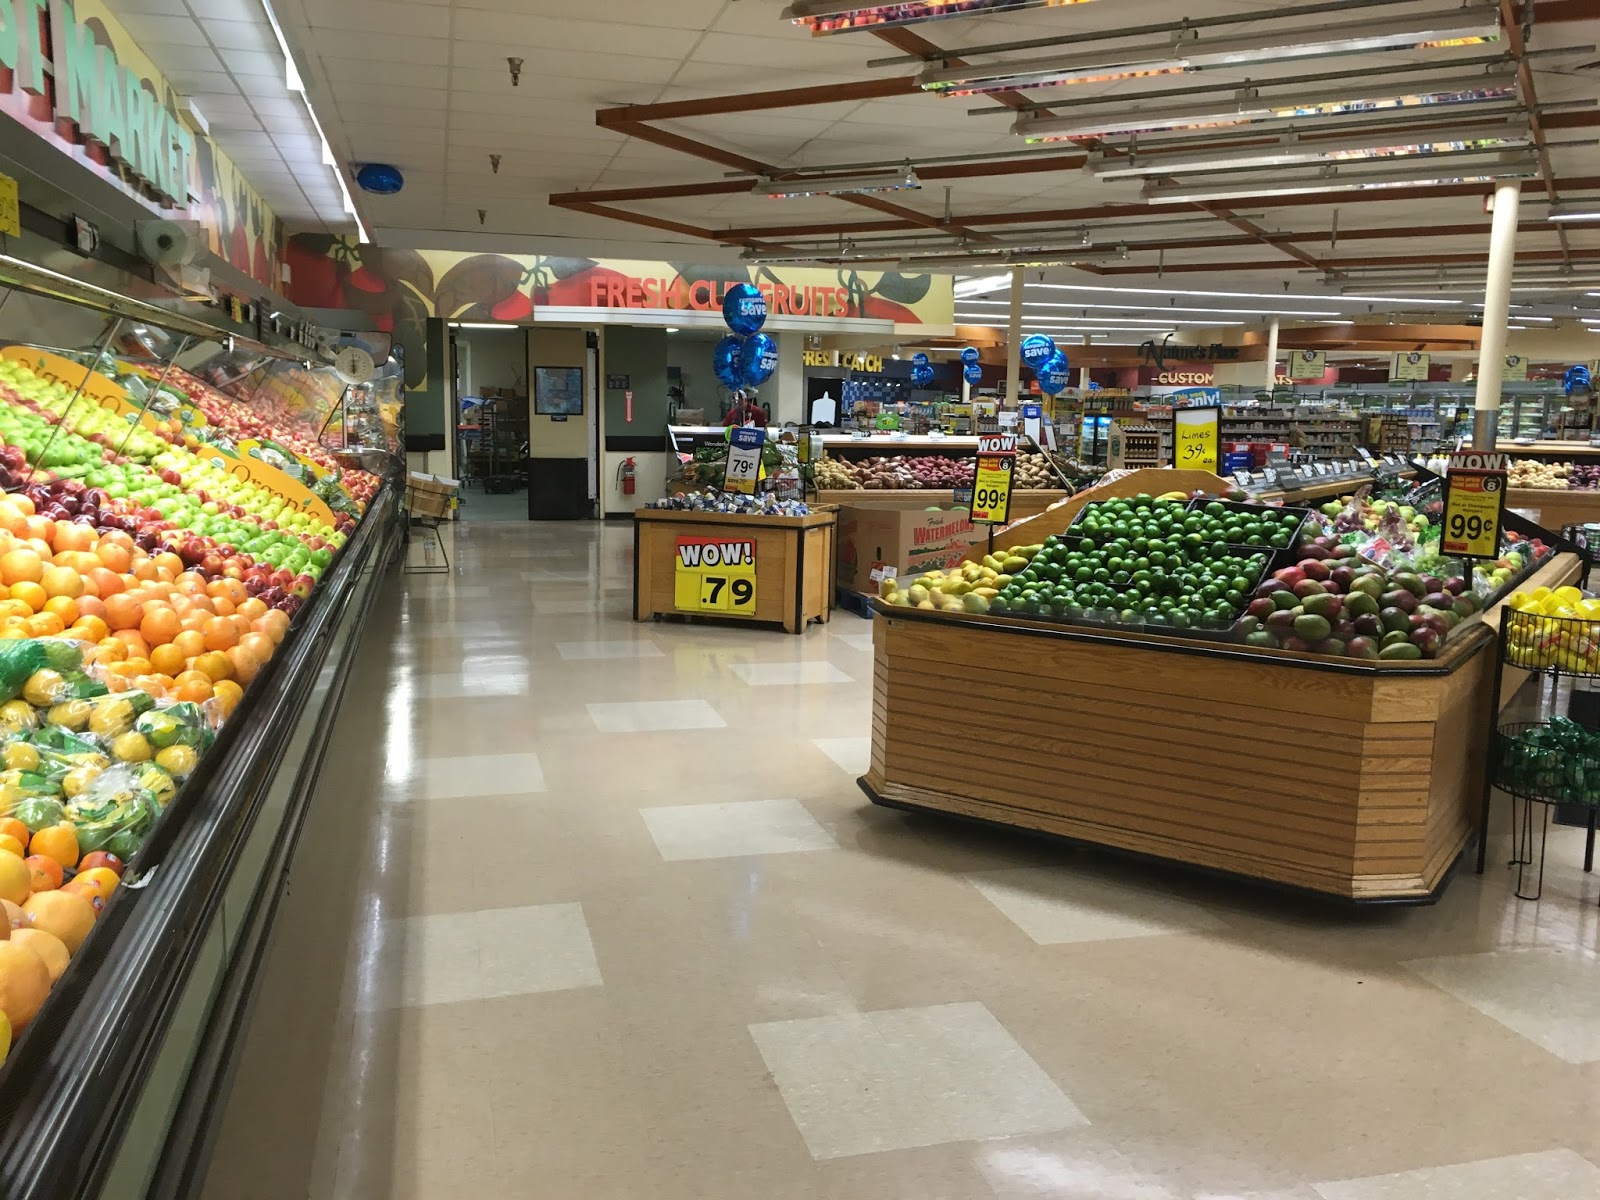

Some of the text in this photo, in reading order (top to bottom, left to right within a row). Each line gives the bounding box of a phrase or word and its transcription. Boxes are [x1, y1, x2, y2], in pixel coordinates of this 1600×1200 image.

[62, 0, 192, 210] MARKET
[591, 275, 682, 310] FRESH
[689, 280, 746, 312] CU
[740, 302, 767, 316] save
[803, 350, 838, 367] RES
[1024, 346, 1050, 357] save
[760, 358, 777, 370] sav
[1158, 372, 1215, 385] CUSTOM
[1187, 391, 1220, 407] only!
[738, 434, 757, 443] save
[978, 436, 1019, 452] WOW!
[733, 460, 754, 473] 79¢
[1002, 462, 1009, 470] 8
[1449, 454, 1510, 470] WOW!
[1487, 482, 1496, 491] 8
[977, 488, 1006, 510] 99¢
[914, 517, 975, 546] WATERMELONS
[1450, 513, 1494, 541] 99¢
[678, 542, 753, 568] WOW!
[702, 576, 753, 606] .79
